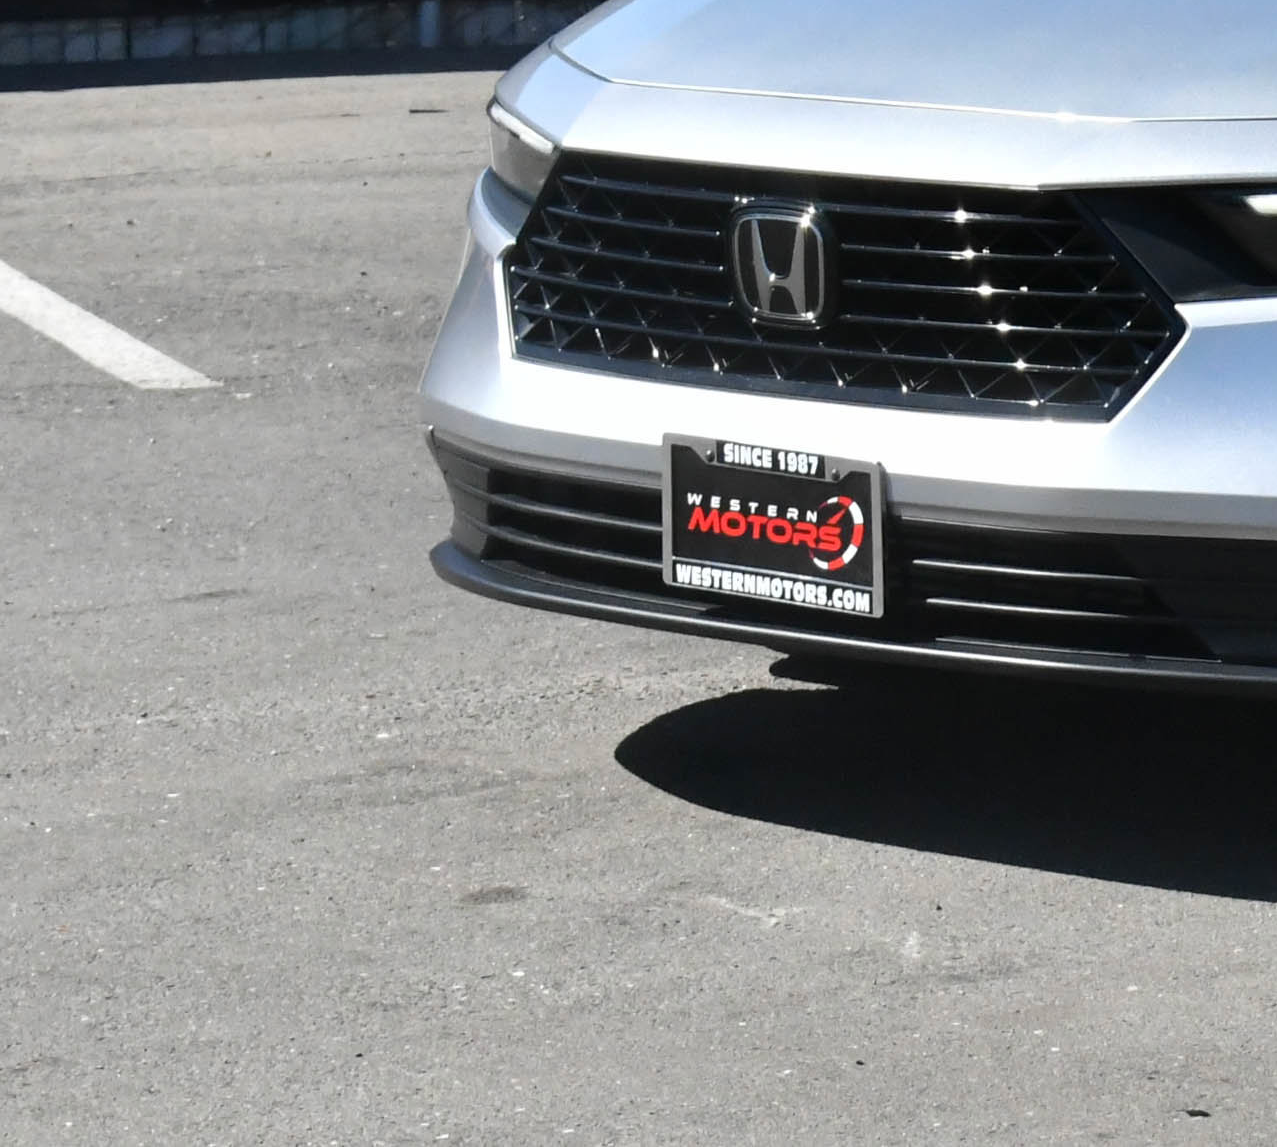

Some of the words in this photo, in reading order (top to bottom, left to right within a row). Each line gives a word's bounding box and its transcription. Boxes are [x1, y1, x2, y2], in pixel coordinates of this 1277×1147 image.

[723, 442, 773, 469] SINCE
[777, 452, 820, 475] 1987
[686, 492, 818, 523] WESTERN
[687, 506, 843, 552] MOTORS
[675, 563, 871, 613] WESTERNMOTORS.COM
